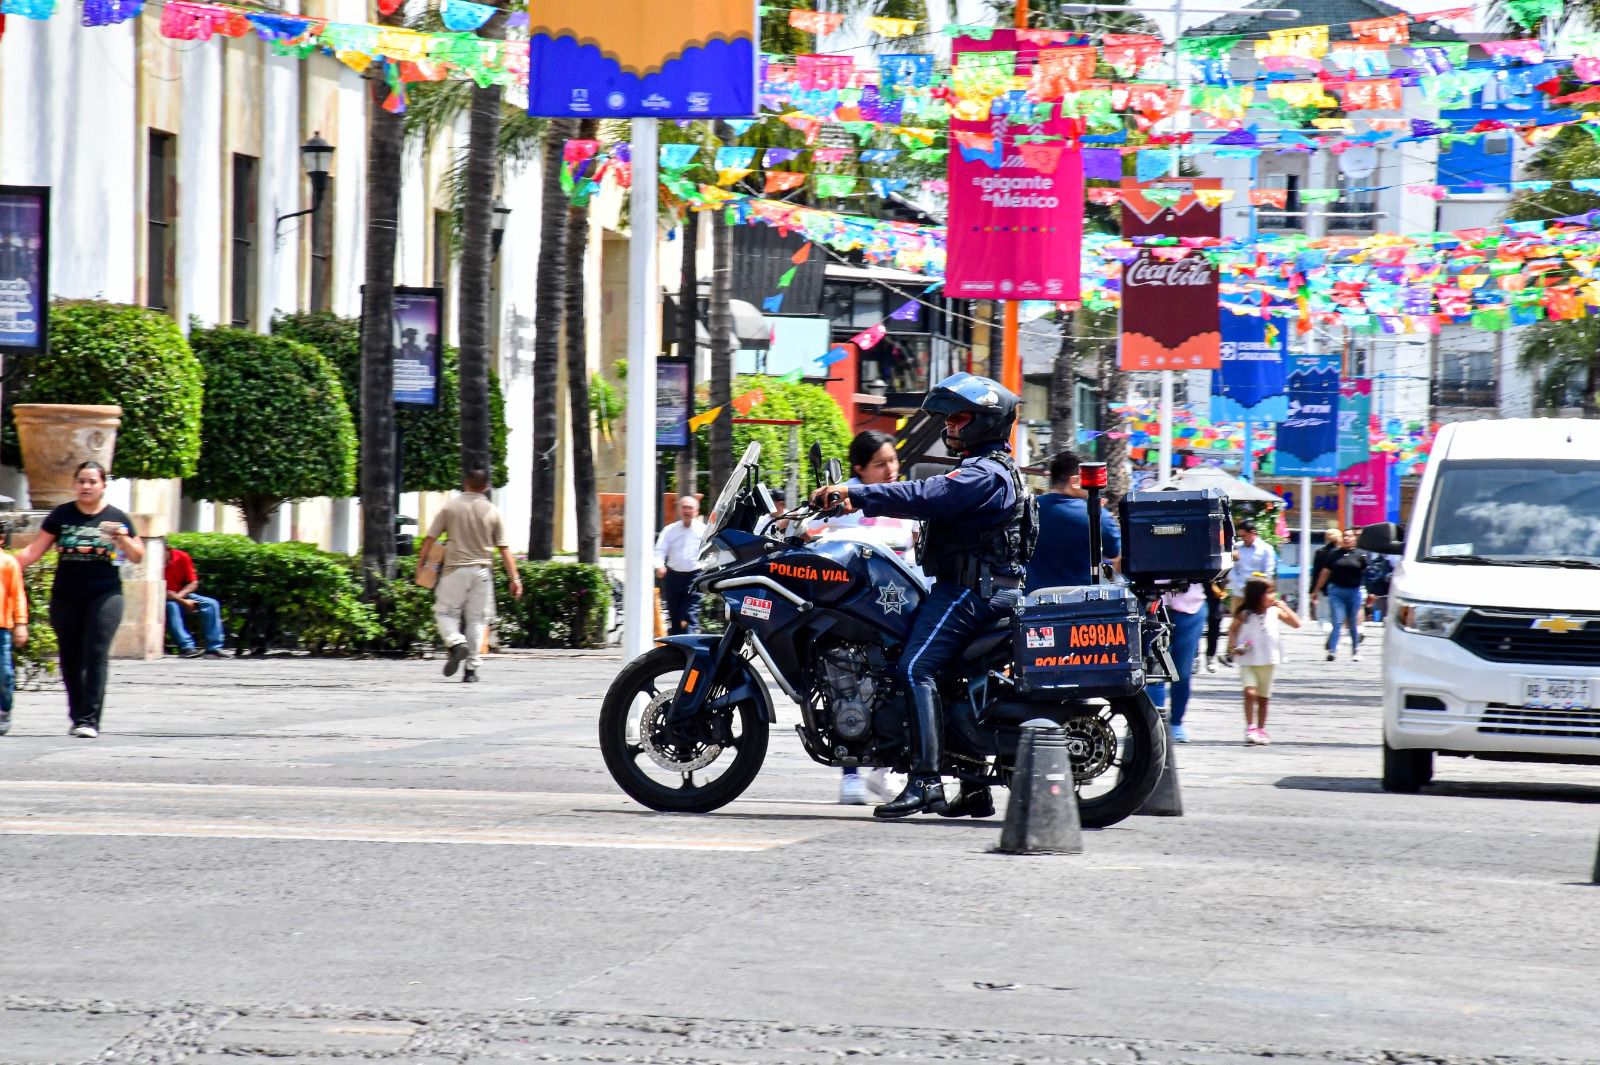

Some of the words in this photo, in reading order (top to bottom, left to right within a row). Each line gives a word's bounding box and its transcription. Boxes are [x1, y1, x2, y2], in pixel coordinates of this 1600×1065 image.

[981, 174, 1053, 193] gigante
[992, 192, 1059, 208] México
[769, 562, 818, 580] POLICÍA
[822, 568, 850, 582] VIAL
[1070, 623, 1126, 647] AG98AA
